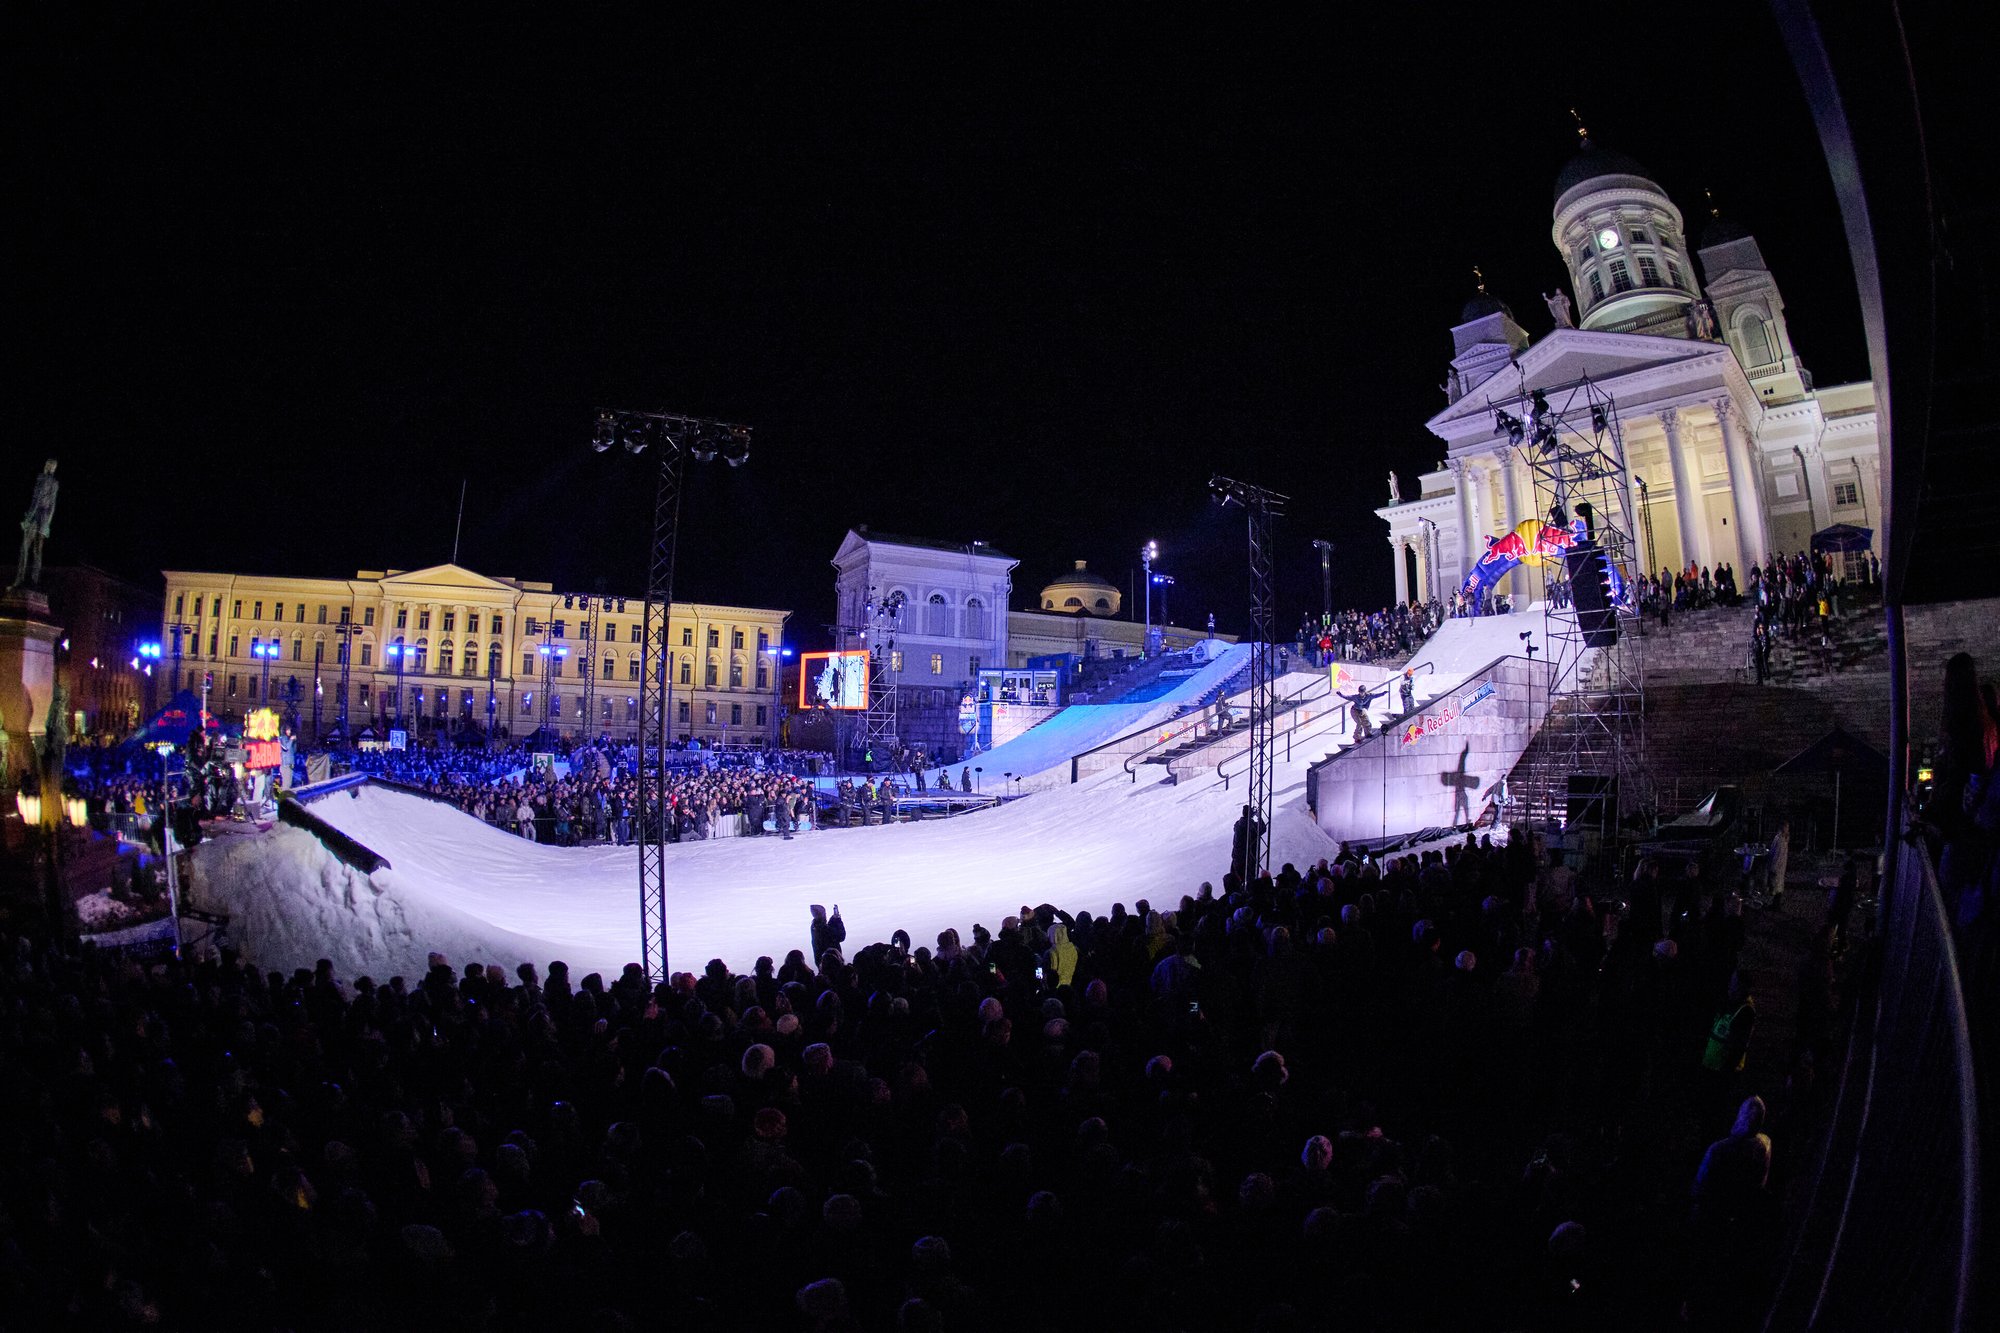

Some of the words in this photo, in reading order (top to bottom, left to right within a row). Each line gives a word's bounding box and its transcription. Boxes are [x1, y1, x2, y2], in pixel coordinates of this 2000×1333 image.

[1427, 712, 1443, 733] Red
[1443, 702, 1459, 723] Bull
[251, 742, 267, 768] Red
[266, 741, 281, 767] Bull
